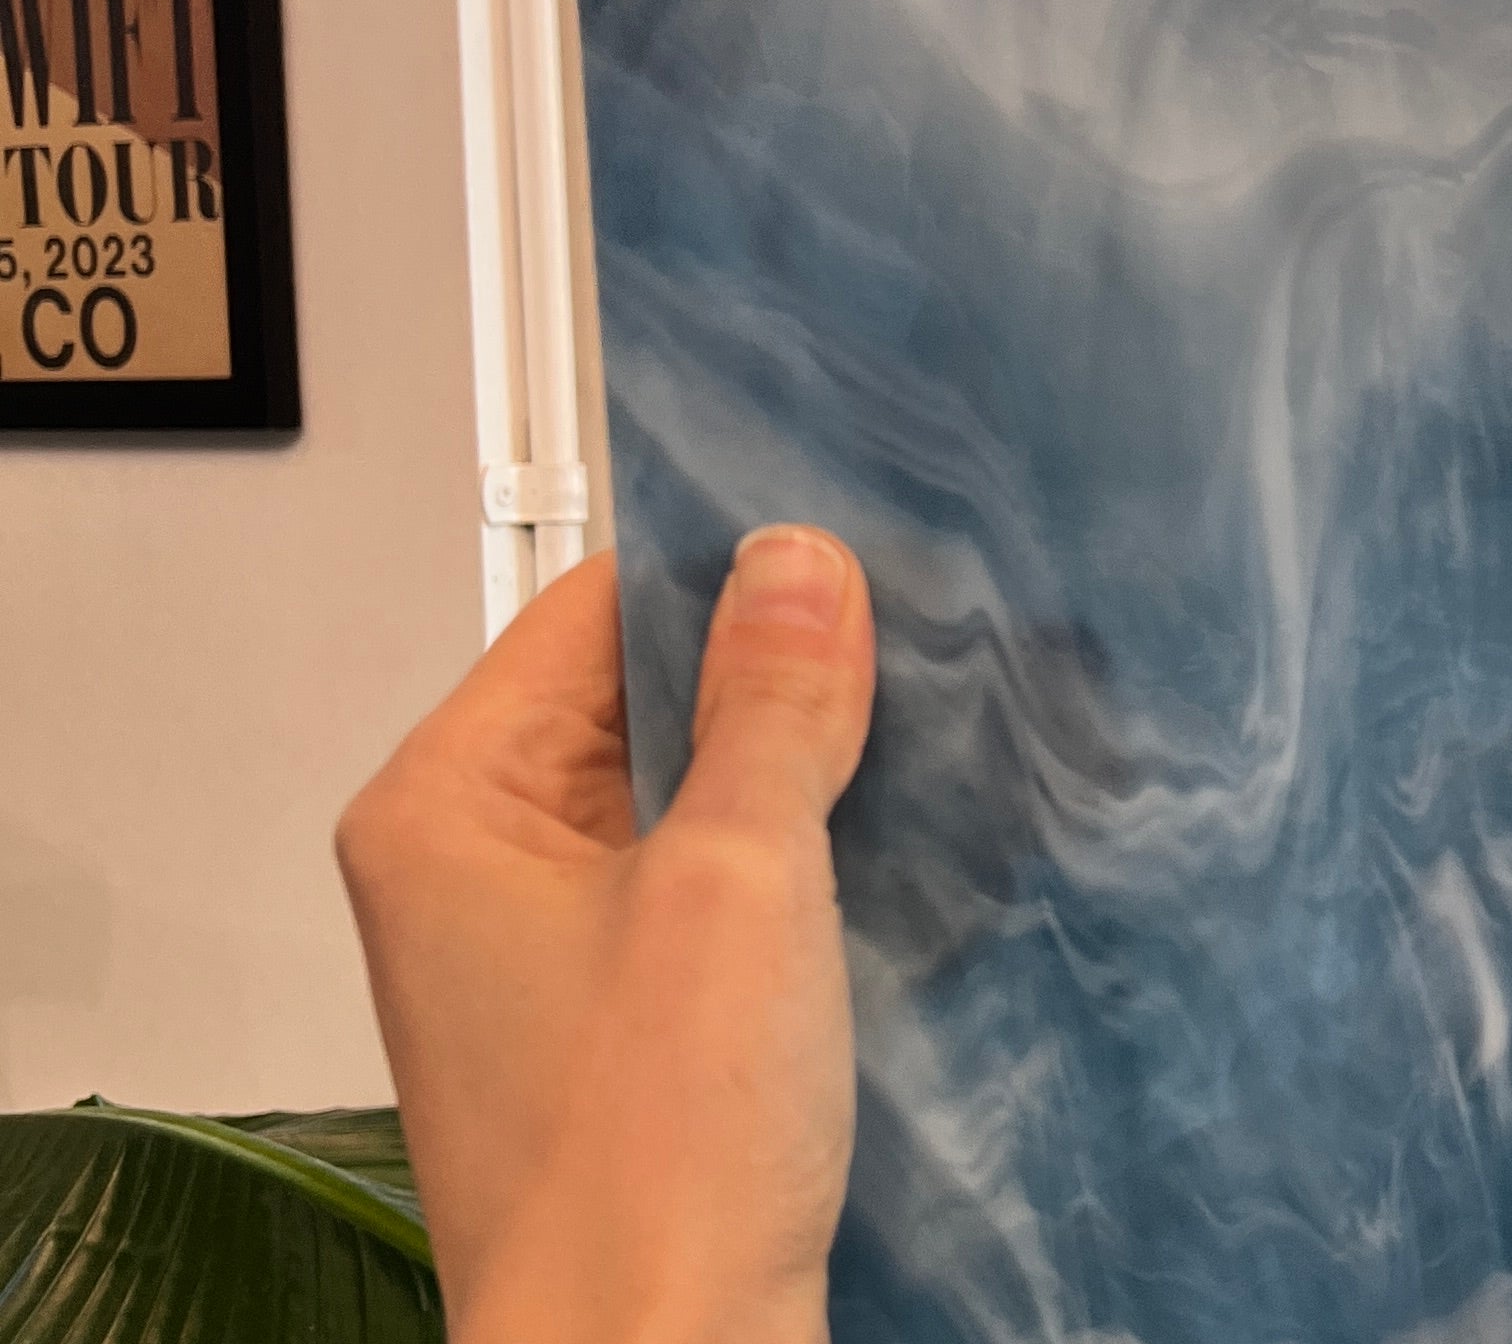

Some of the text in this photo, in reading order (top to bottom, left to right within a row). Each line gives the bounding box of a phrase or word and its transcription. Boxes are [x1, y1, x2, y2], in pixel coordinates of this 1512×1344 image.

[4, 140, 220, 228] TOUR
[44, 233, 155, 283] 2023
[22, 286, 137, 370] CO
